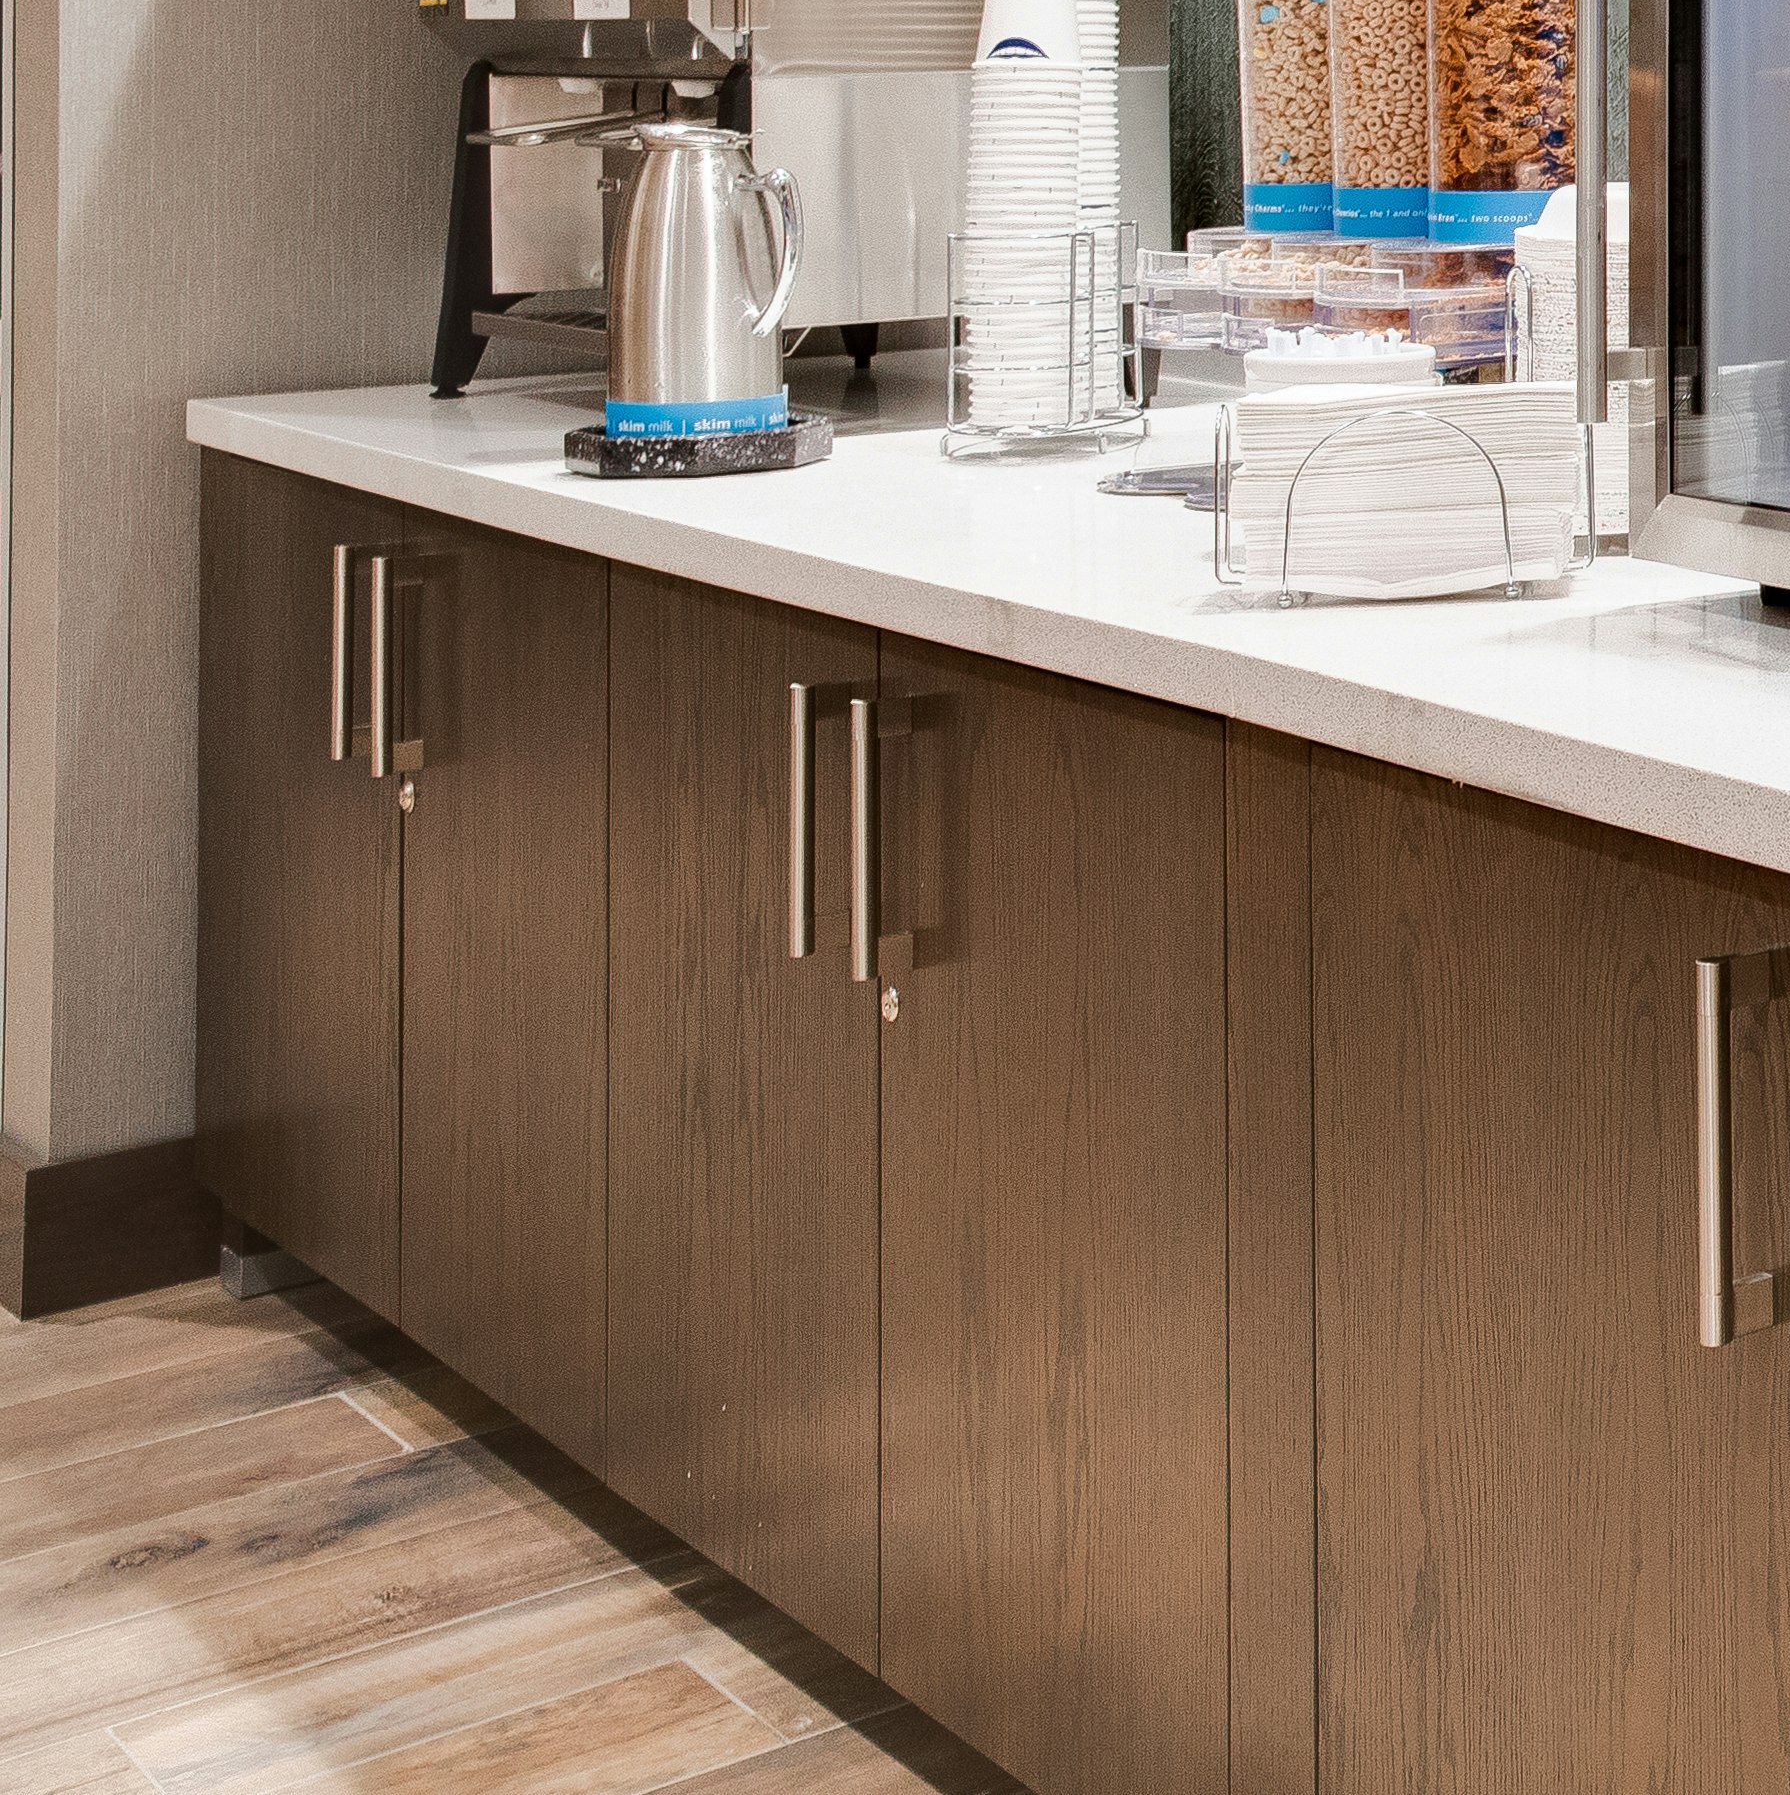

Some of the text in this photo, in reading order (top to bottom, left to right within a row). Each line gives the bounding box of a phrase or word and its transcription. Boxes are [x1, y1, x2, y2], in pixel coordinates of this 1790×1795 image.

[1470, 214, 1490, 223] two
[618, 419, 646, 433] skim
[648, 419, 674, 432] milk
[693, 418, 731, 432] skim
[734, 414, 757, 428] milk
